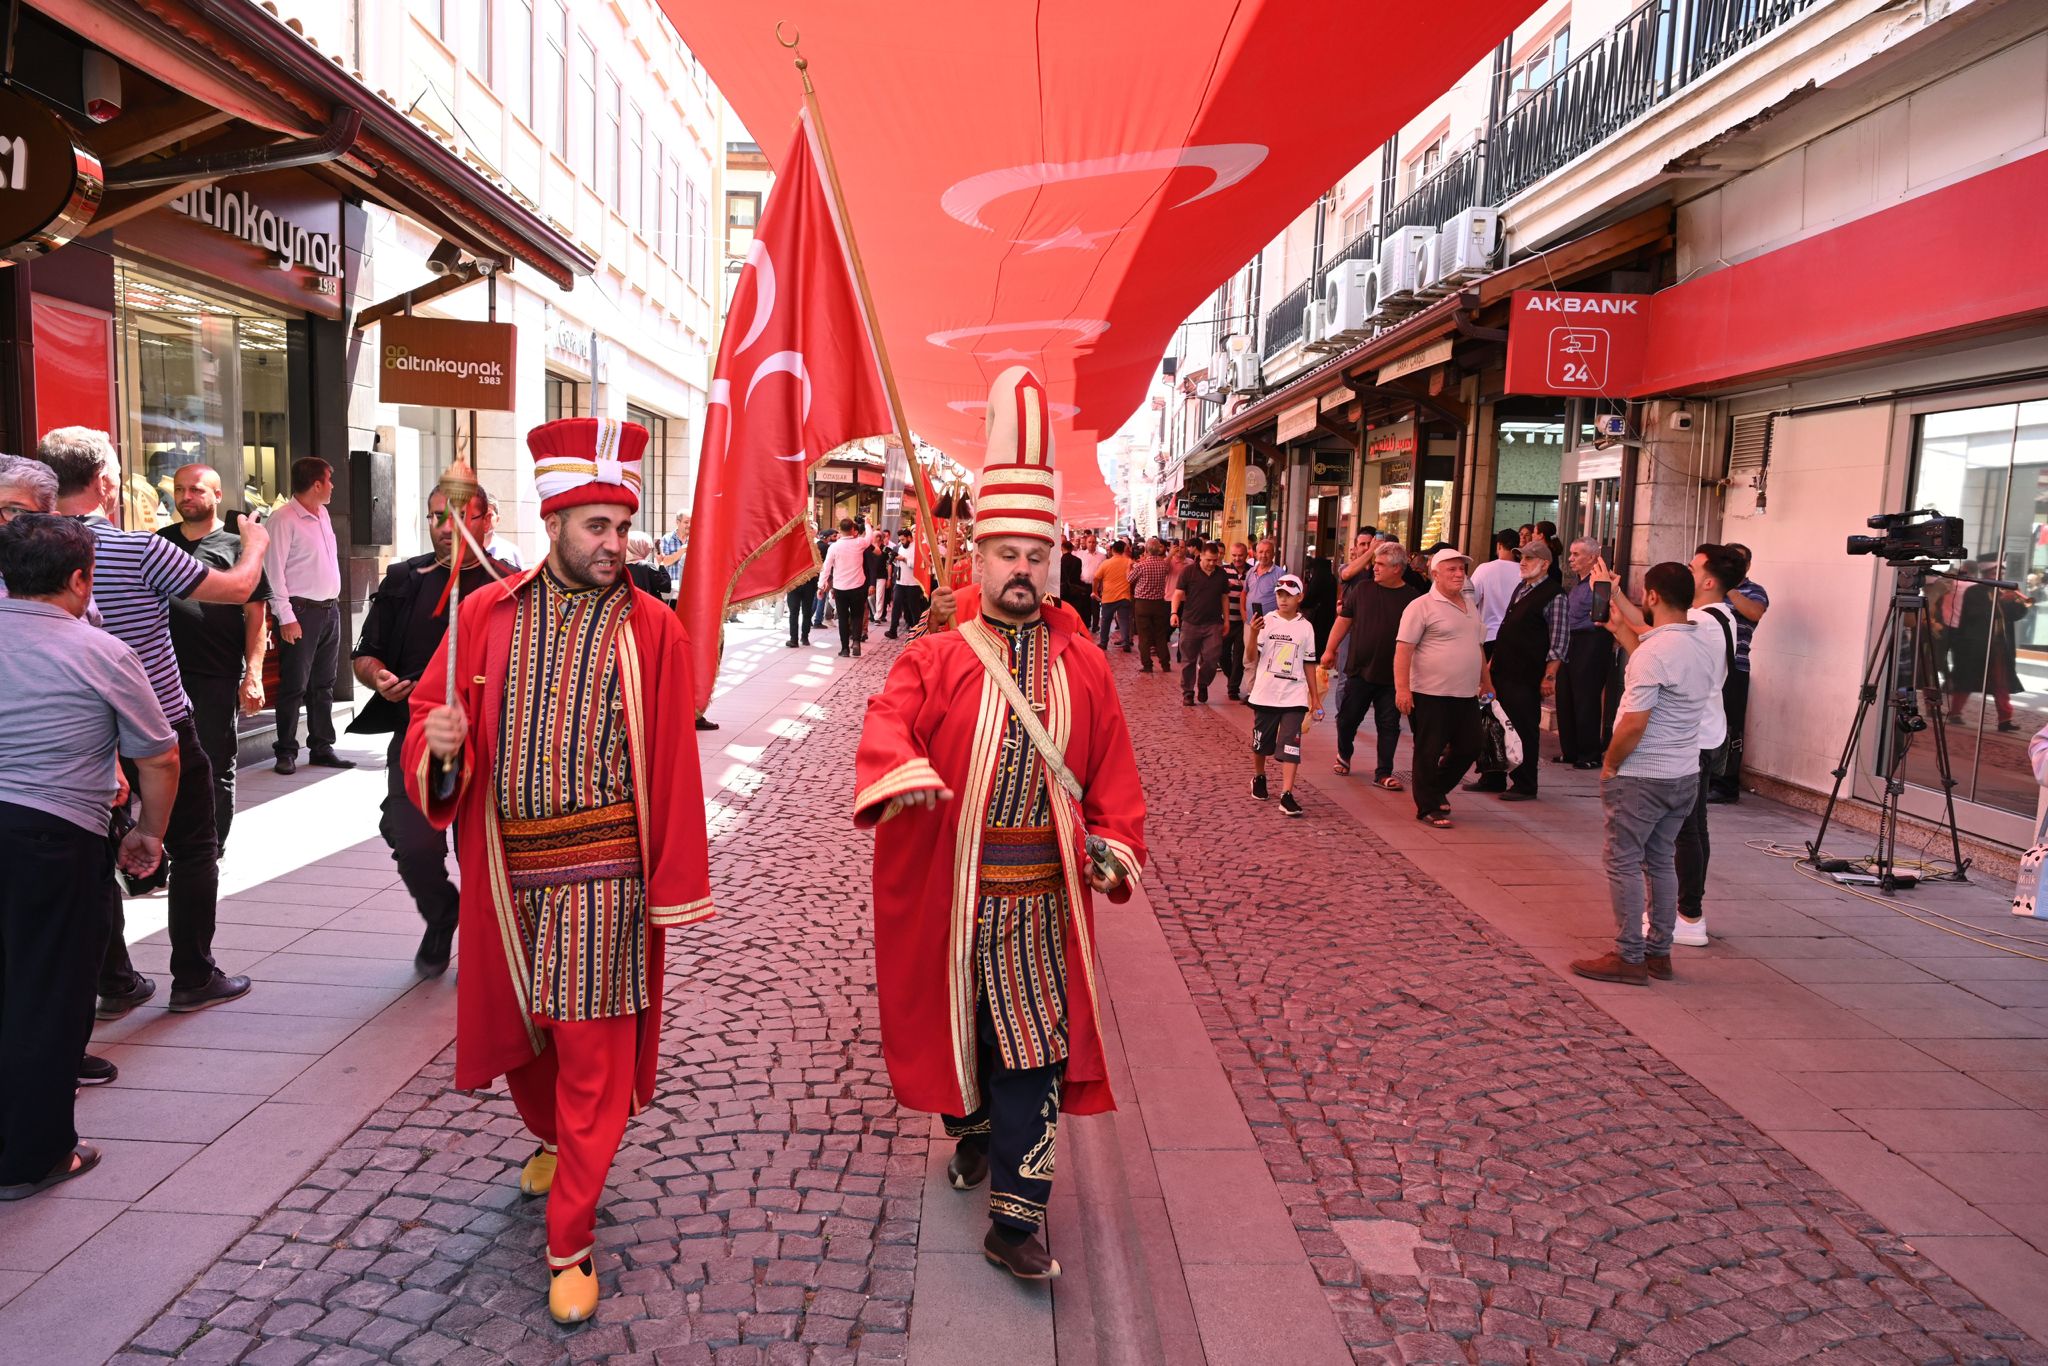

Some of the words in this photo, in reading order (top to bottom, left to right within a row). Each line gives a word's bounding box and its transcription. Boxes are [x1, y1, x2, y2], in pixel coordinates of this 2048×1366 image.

[318, 277, 337, 296] 1983
[1525, 297, 1639, 315] AKBANK
[478, 376, 501, 385] 1983
[1562, 363, 1589, 383] 24
